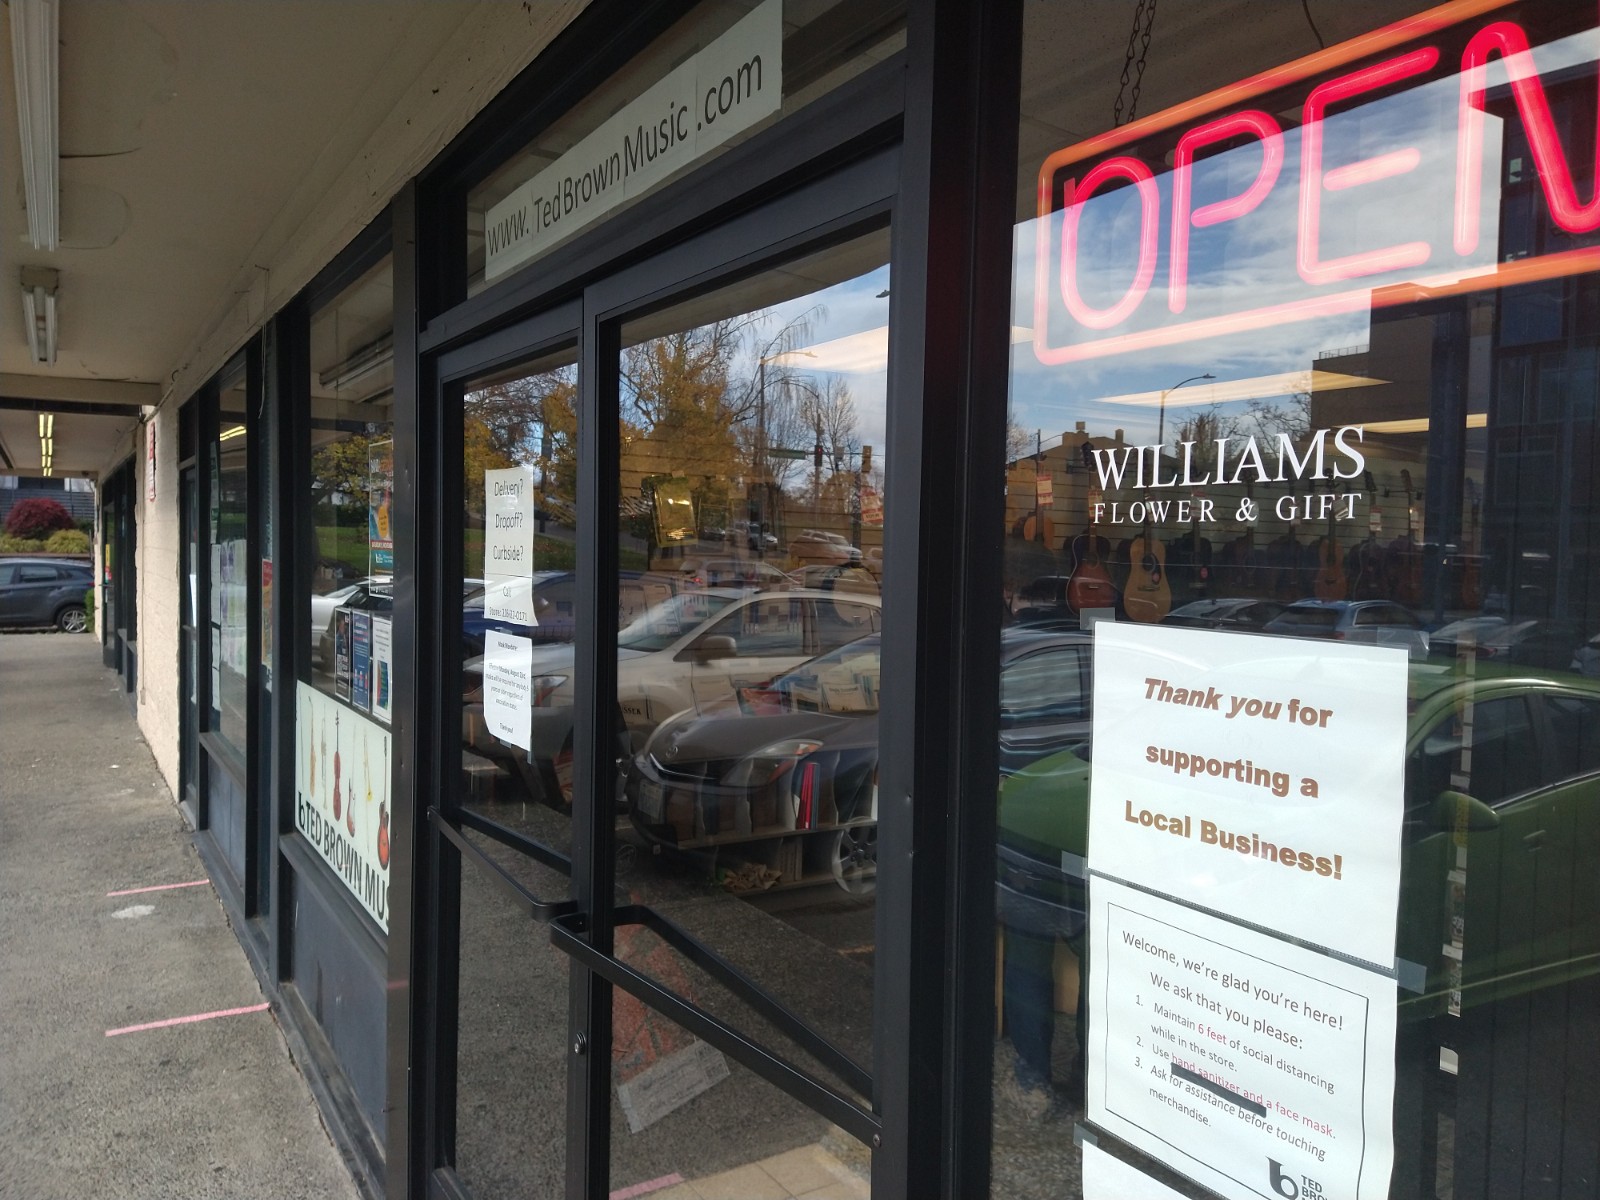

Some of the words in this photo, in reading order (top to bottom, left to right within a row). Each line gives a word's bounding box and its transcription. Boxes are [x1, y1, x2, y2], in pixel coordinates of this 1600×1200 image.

[1061, 21, 1600, 329] OPEN
[495, 479, 523, 497] Delivery?
[1091, 426, 1365, 491] WILLIAMS
[496, 513, 523, 532] Dropoff?
[1093, 499, 1216, 524] FLOWER
[1235, 497, 1257, 522] &
[1275, 493, 1361, 521] GIFT
[493, 545, 523, 561] Curbside?
[1144, 677, 1223, 710] Thank
[1225, 696, 1282, 720] you
[1288, 699, 1333, 728] for
[1146, 745, 1289, 798] supporting
[1300, 778, 1318, 798] a
[305, 800, 321, 846] TED
[324, 825, 362, 896] BROWN
[1125, 800, 1191, 838] Local
[1201, 820, 1342, 880] Business!
[1123, 930, 1179, 966] Welcome,
[1222, 971, 1249, 993] glad
[1304, 1001, 1343, 1031] here!
[1151, 972, 1170, 992] We
[1173, 981, 1192, 1002] ask
[1196, 993, 1221, 1015] that
[1225, 1006, 1249, 1027] you
[1253, 1015, 1303, 1050] please:
[1136, 995, 1143, 1007] 1.
[1154, 1002, 1195, 1031] Maintain
[1198, 1023, 1204, 1035] 6
[1207, 1026, 1226, 1045] feet
[1229, 1035, 1241, 1050] of
[1243, 1042, 1272, 1066] social
[1276, 1056, 1334, 1094] distancing
[1151, 1024, 1175, 1044] while
[1179, 1035, 1186, 1047] in
[1190, 1041, 1206, 1057] the
[1209, 1050, 1237, 1072] store.
[1135, 1056, 1143, 1069] 3.
[1150, 1065, 1166, 1082] Ask
[1169, 1073, 1183, 1090] for
[1185, 1083, 1235, 1116] assistance
[1238, 1107, 1272, 1134] before
[1276, 1126, 1325, 1162] touching
[1136, 1036, 1144, 1048] 2.
[1152, 1044, 1169, 1061] Use
[1171, 1054, 1195, 1073] hand
[1198, 1066, 1240, 1095] sanitizer
[1243, 1087, 1263, 1106] and
[1266, 1099, 1272, 1109] a
[1275, 1100, 1299, 1122] face
[1302, 1114, 1336, 1139] mask.
[1149, 1087, 1211, 1127] merchandise.
[1301, 1174, 1323, 1194] TED
